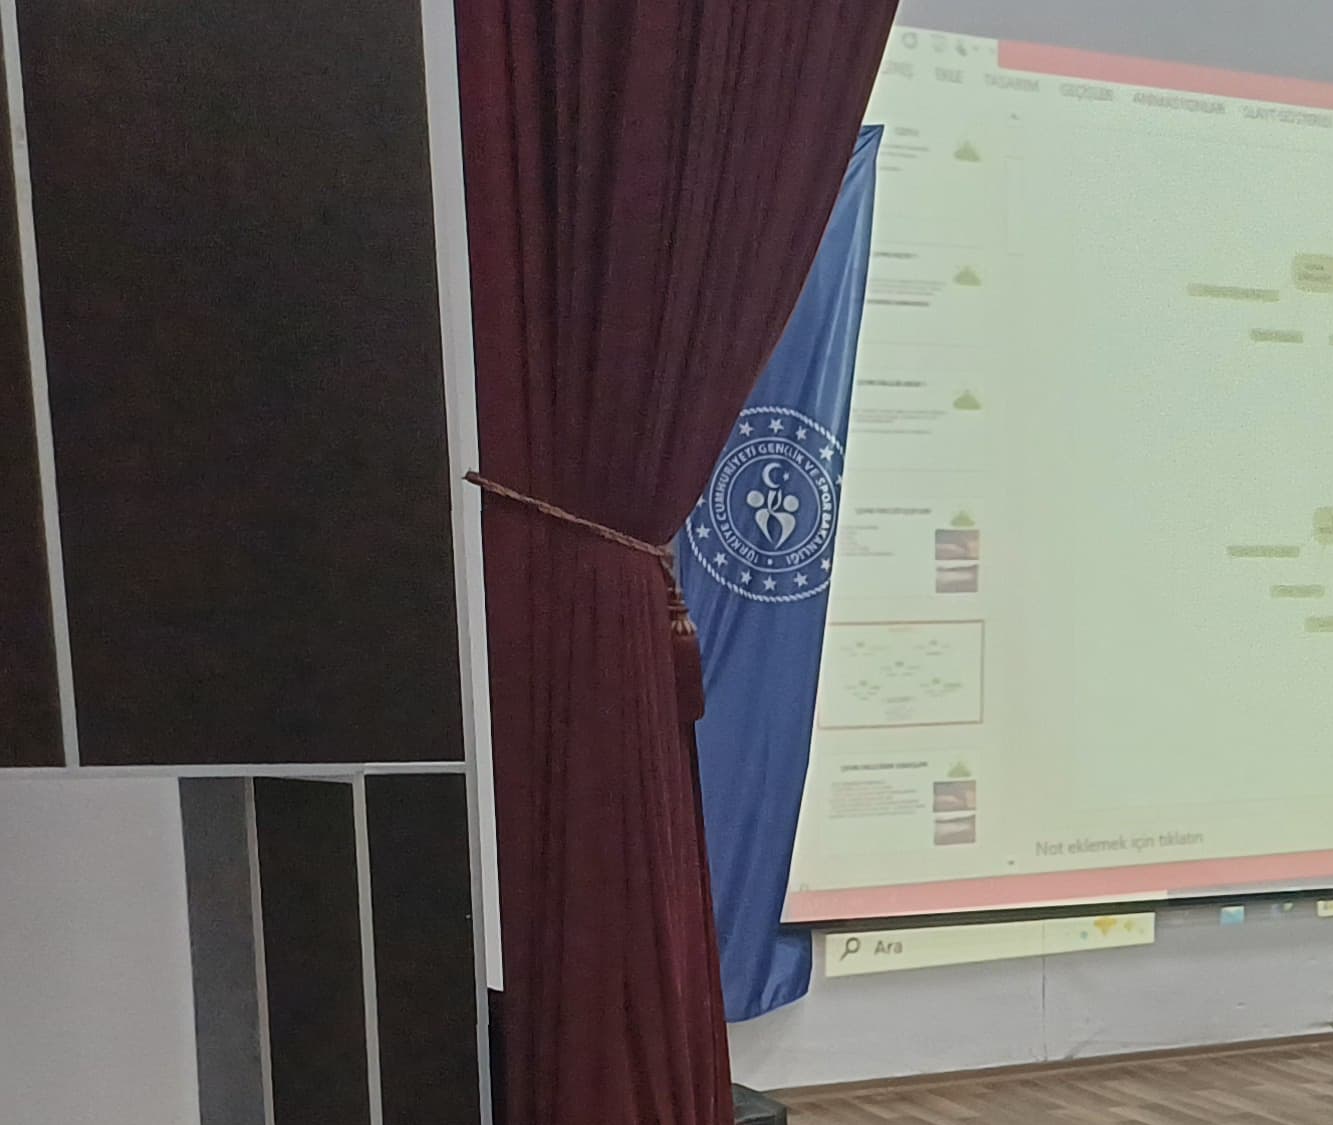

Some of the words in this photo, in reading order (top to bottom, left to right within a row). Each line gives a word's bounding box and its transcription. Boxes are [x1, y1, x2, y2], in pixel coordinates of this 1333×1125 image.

[804, 460, 820, 478] VE
[816, 477, 832, 510] SPOR
[1035, 839, 1064, 856] Not
[1067, 833, 1129, 855] eklemek
[873, 938, 904, 956] Ara
